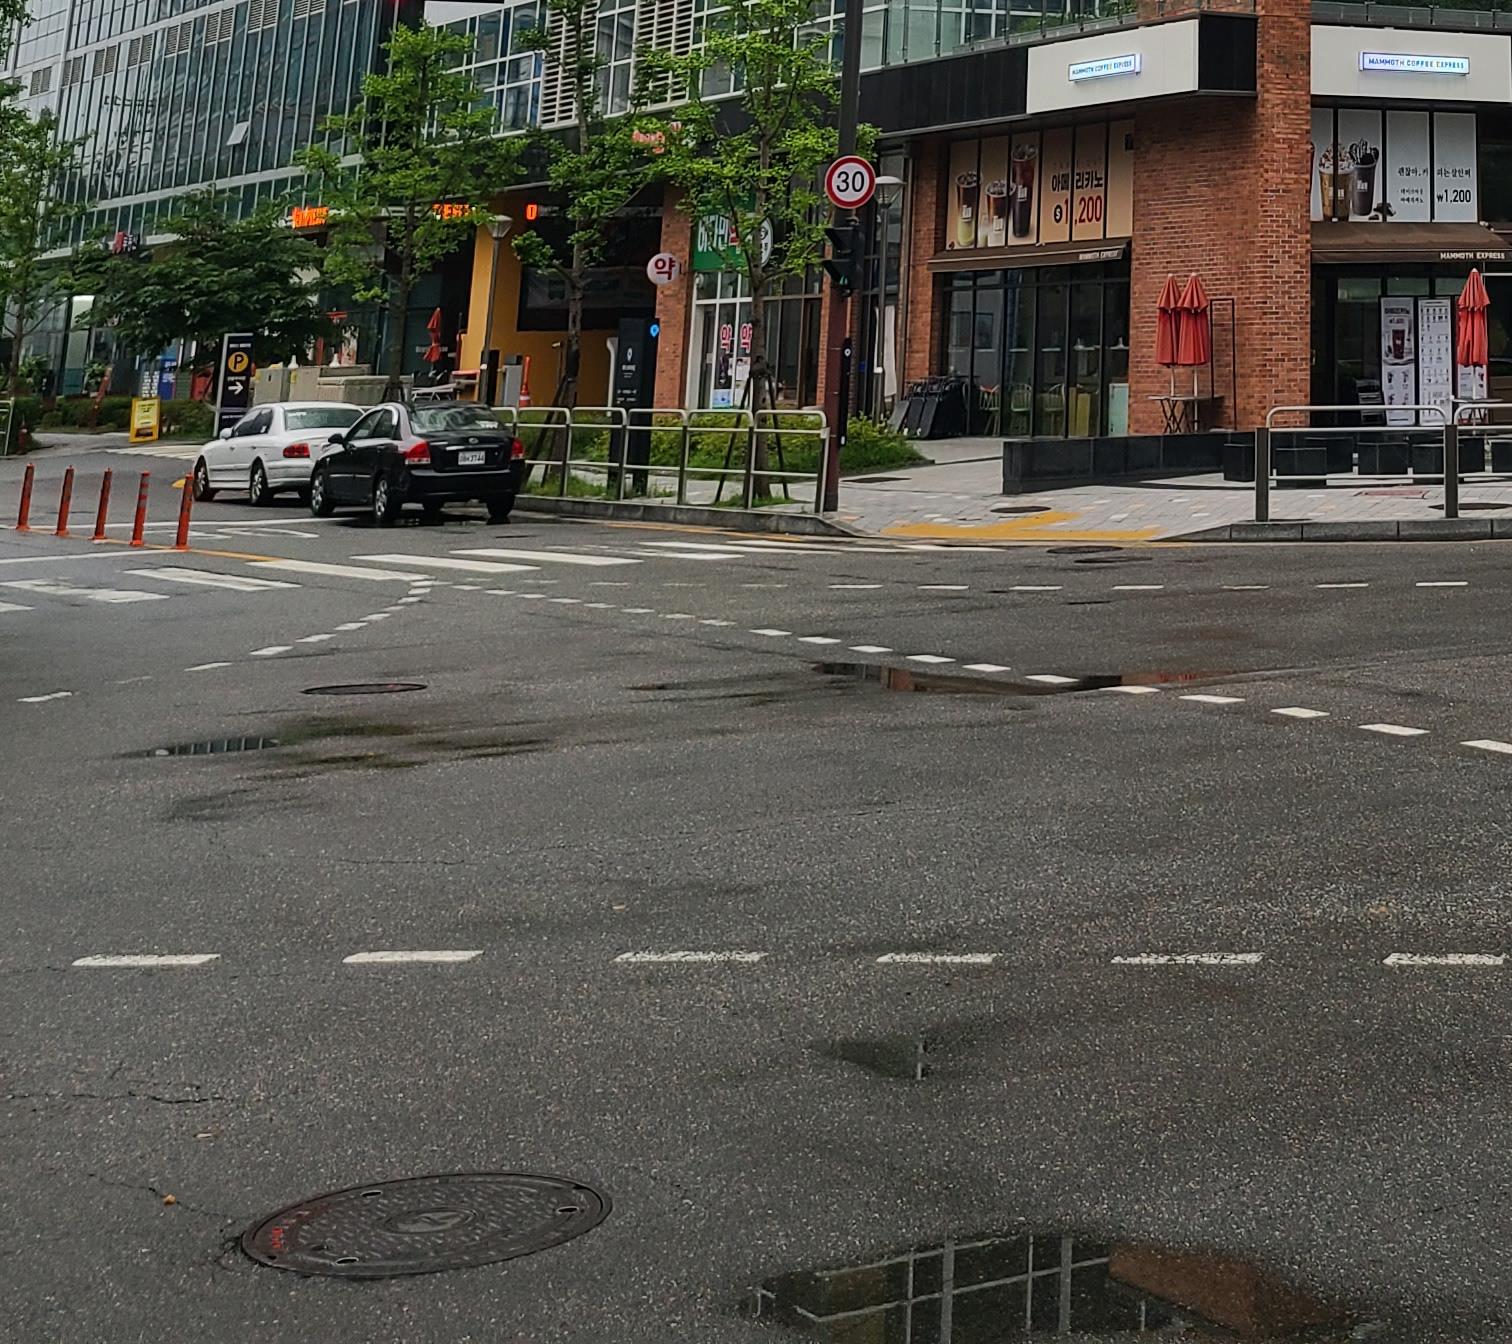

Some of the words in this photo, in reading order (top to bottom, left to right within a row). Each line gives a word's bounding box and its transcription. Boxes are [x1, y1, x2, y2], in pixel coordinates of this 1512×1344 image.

[1369, 58, 1405, 66] MAMMOTH
[836, 170, 865, 192] 30
[1051, 170, 1104, 192] 아메리카노
[654, 257, 676, 281] 약
[720, 324, 732, 353] 약
